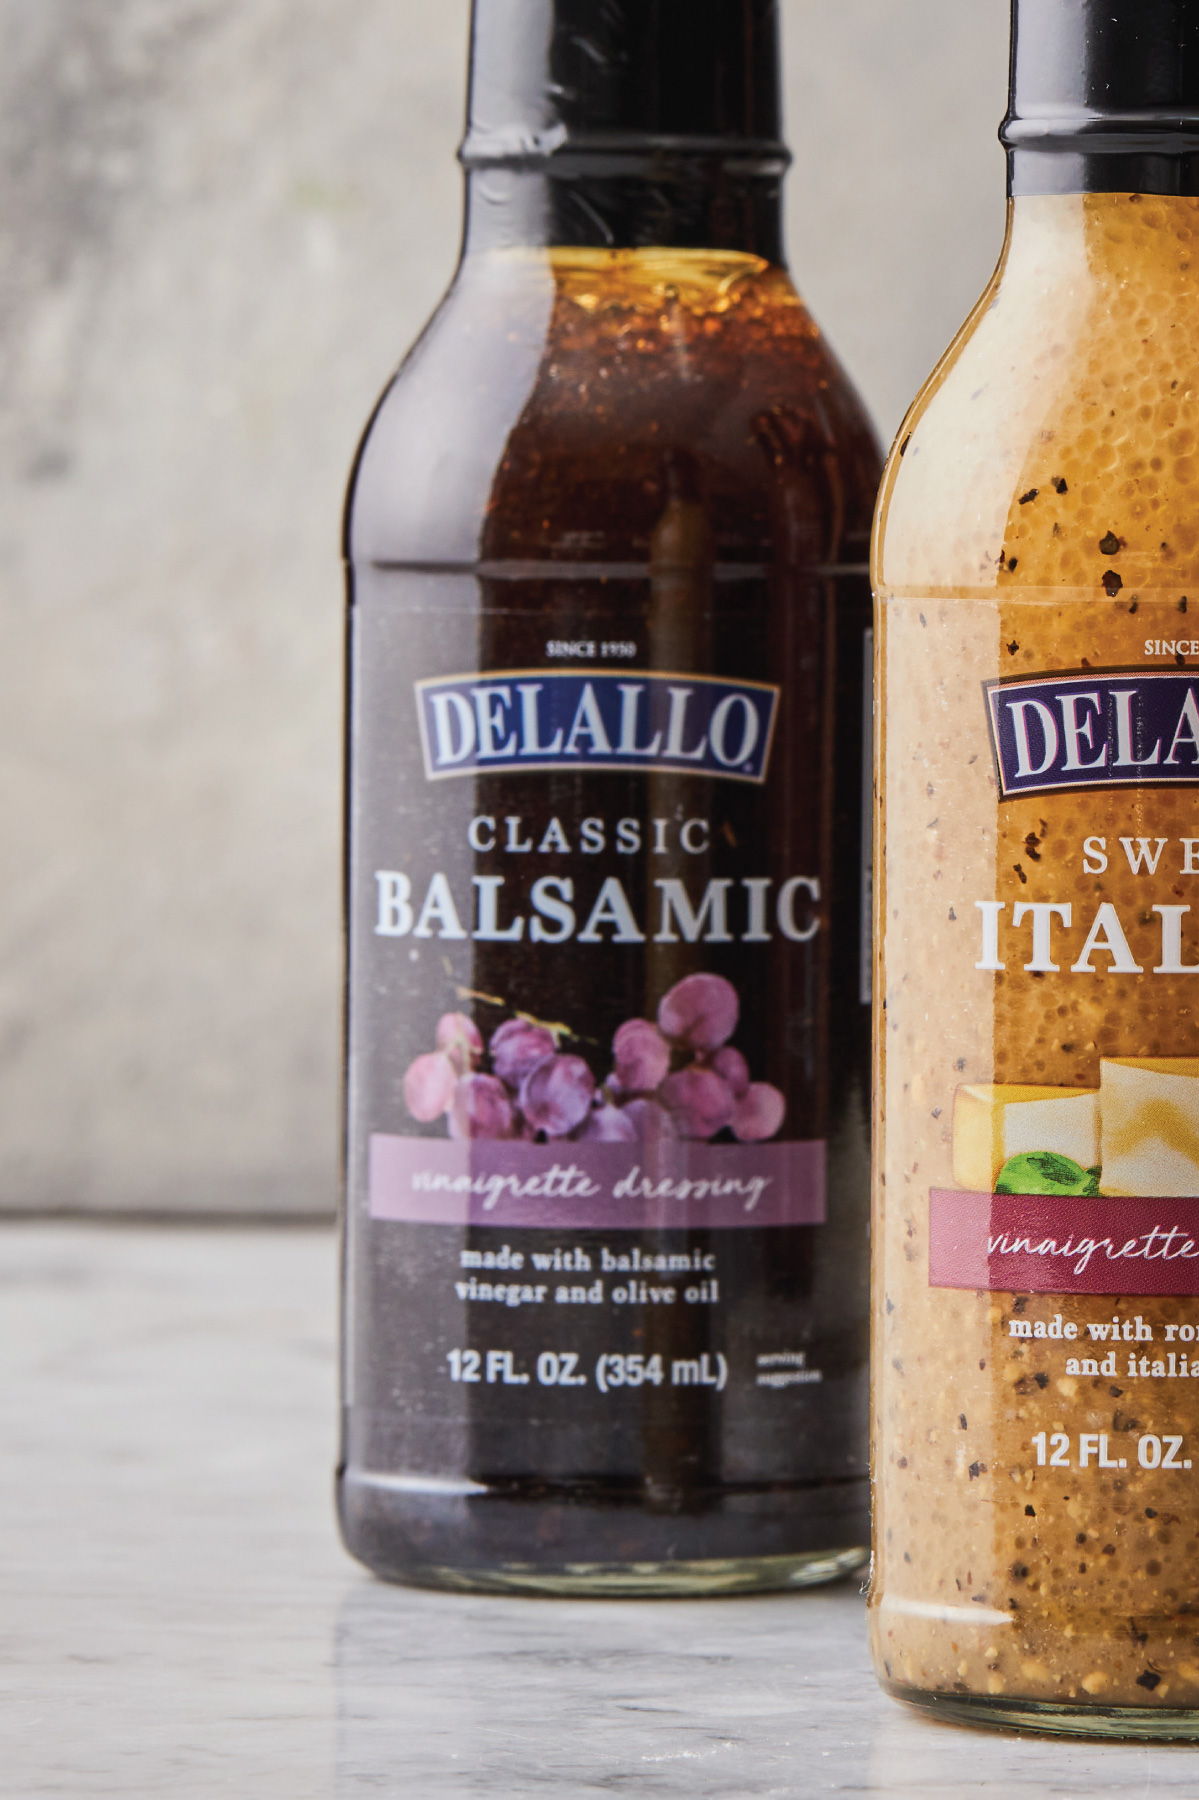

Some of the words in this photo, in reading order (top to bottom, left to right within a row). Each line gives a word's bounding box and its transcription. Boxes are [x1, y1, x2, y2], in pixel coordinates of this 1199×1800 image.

[546, 641, 596, 657] SINCE
[1144, 640, 1199, 655] SINCE
[430, 683, 758, 767] DELALLO
[468, 816, 709, 853] CLASSIC
[375, 871, 821, 942] BALSAMIC
[412, 1165, 600, 1210] vinaigrette
[613, 1167, 771, 1210] dressing
[461, 1246, 523, 1269] made
[532, 1248, 591, 1270] with
[602, 1249, 715, 1270] balsamic
[456, 1279, 546, 1307] vinegar
[556, 1279, 602, 1304] and
[612, 1279, 675, 1304] olive
[685, 1280, 719, 1303] oil
[1009, 1315, 1078, 1340] made
[1087, 1317, 1154, 1341] with
[447, 1350, 481, 1382] 12
[487, 1352, 528, 1384] FL.
[538, 1352, 586, 1385] OZ.
[596, 1353, 663, 1392] (354
[672, 1353, 727, 1389] mL)
[1065, 1353, 1116, 1377] and
[1032, 1431, 1070, 1466] 12
[1080, 1434, 1127, 1468] FL.
[1137, 1435, 1192, 1469] OZ.
